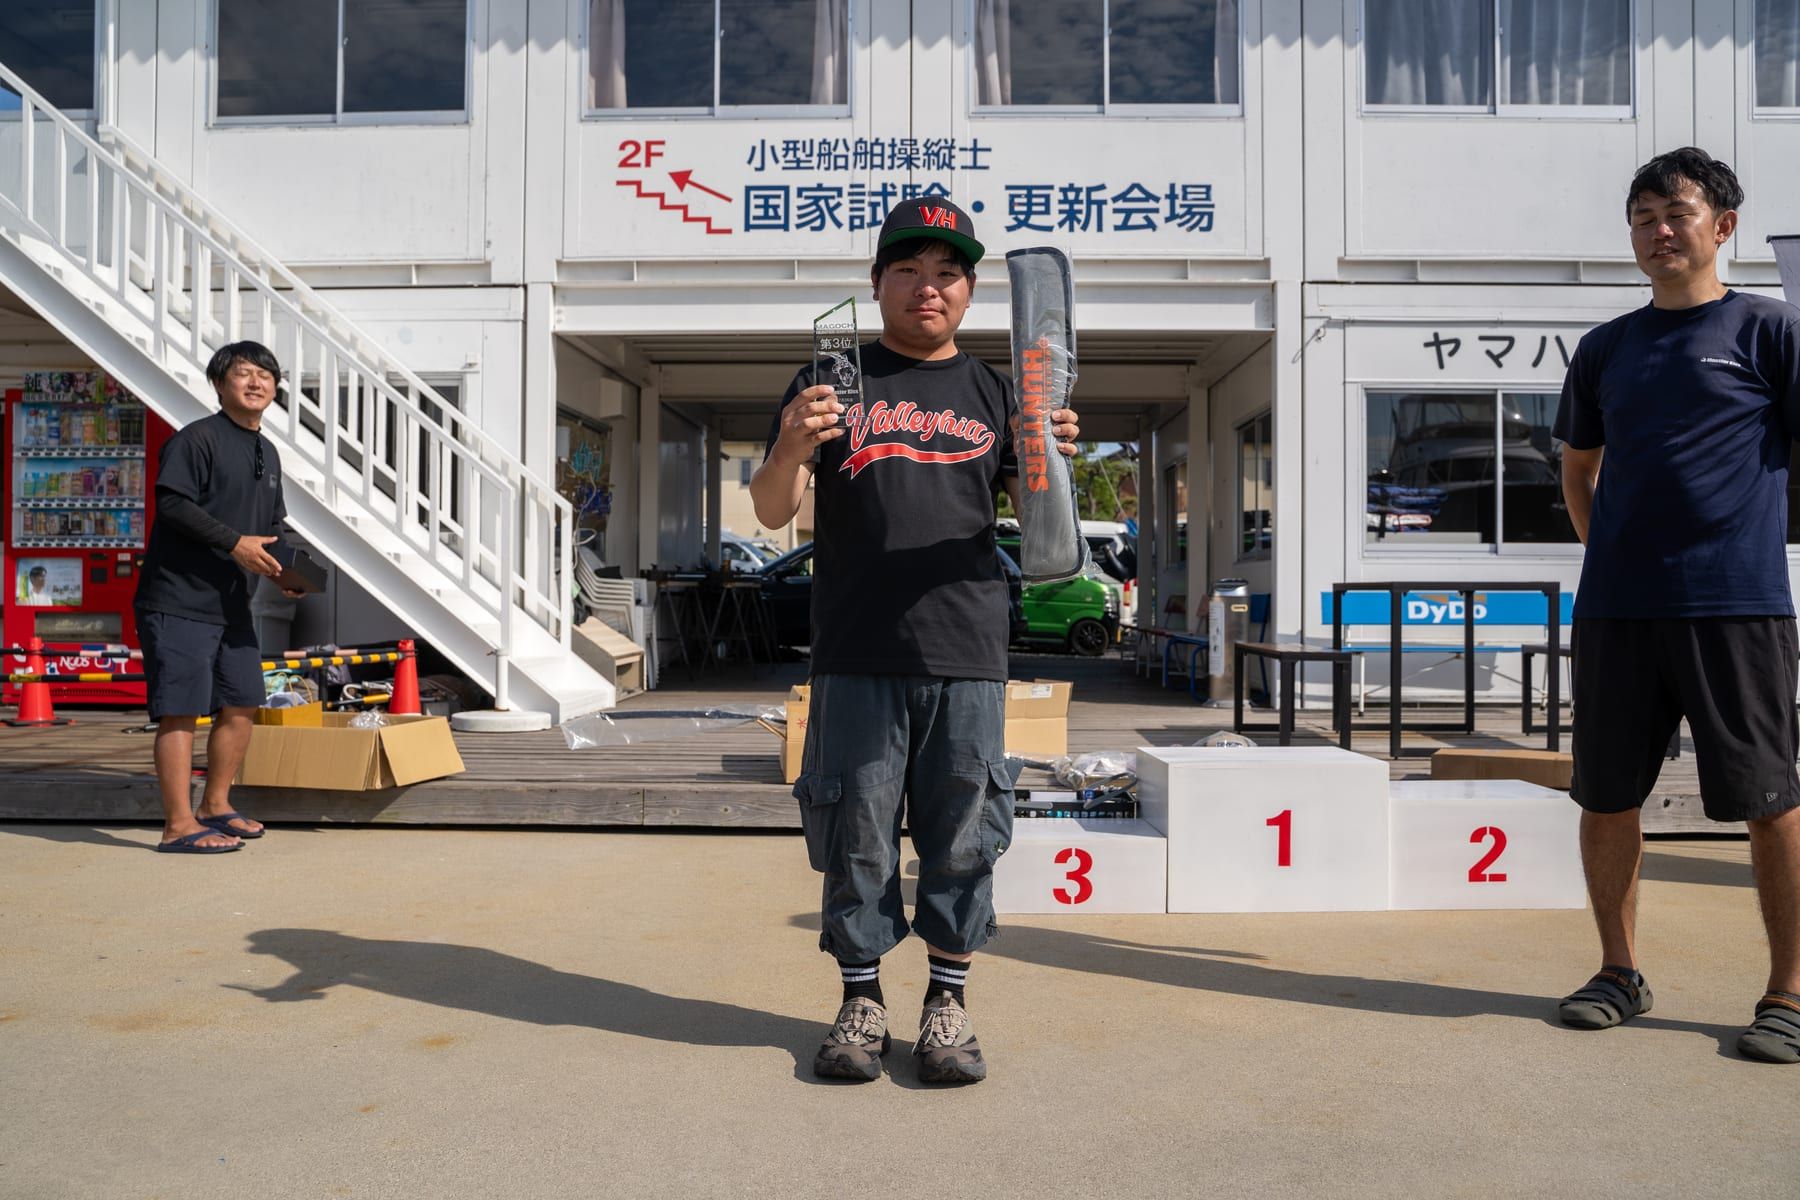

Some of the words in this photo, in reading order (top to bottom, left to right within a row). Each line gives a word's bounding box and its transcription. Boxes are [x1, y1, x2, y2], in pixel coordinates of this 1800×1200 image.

[618, 140, 665, 168] 2F
[746, 138, 991, 172] 小型船舶操縦士
[743, 182, 1214, 232] 国家試・更新会場
[918, 205, 957, 231] VH
[820, 338, 853, 350] 第3位
[1423, 332, 1570, 370] ヤマハ
[1022, 348, 1049, 493] HUNTERS
[1407, 600, 1487, 624] DyDo
[1265, 809, 1292, 867] 1
[1467, 826, 1508, 883] 2
[1052, 847, 1093, 905] 3
